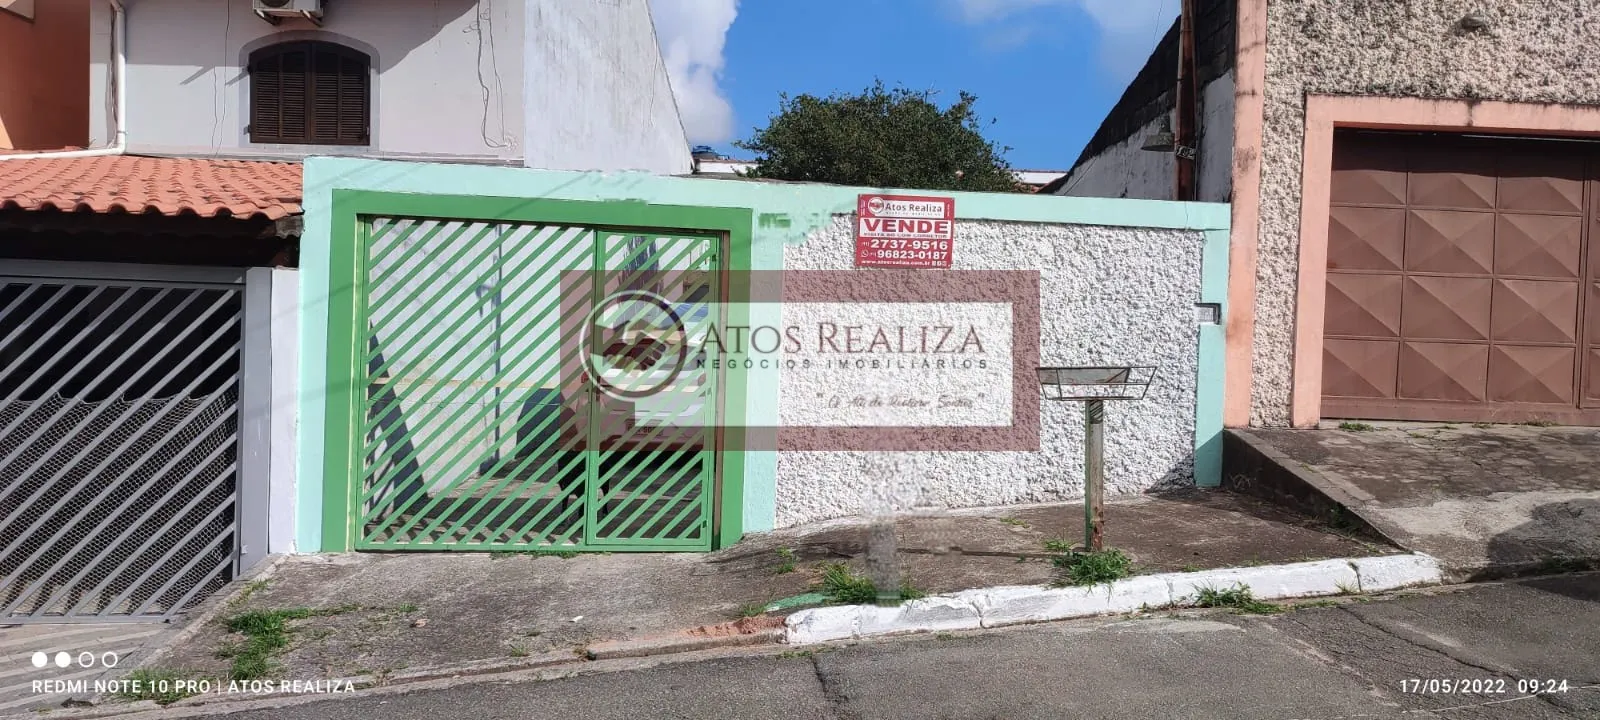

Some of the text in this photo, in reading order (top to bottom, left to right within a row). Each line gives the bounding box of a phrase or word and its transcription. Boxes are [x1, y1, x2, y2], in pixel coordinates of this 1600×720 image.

[885, 203, 907, 211] Atos
[909, 203, 942, 212] Realiza
[864, 218, 949, 235] VENDE
[870, 239, 948, 251] 2737-9516
[877, 249, 948, 260] 96823-0187
